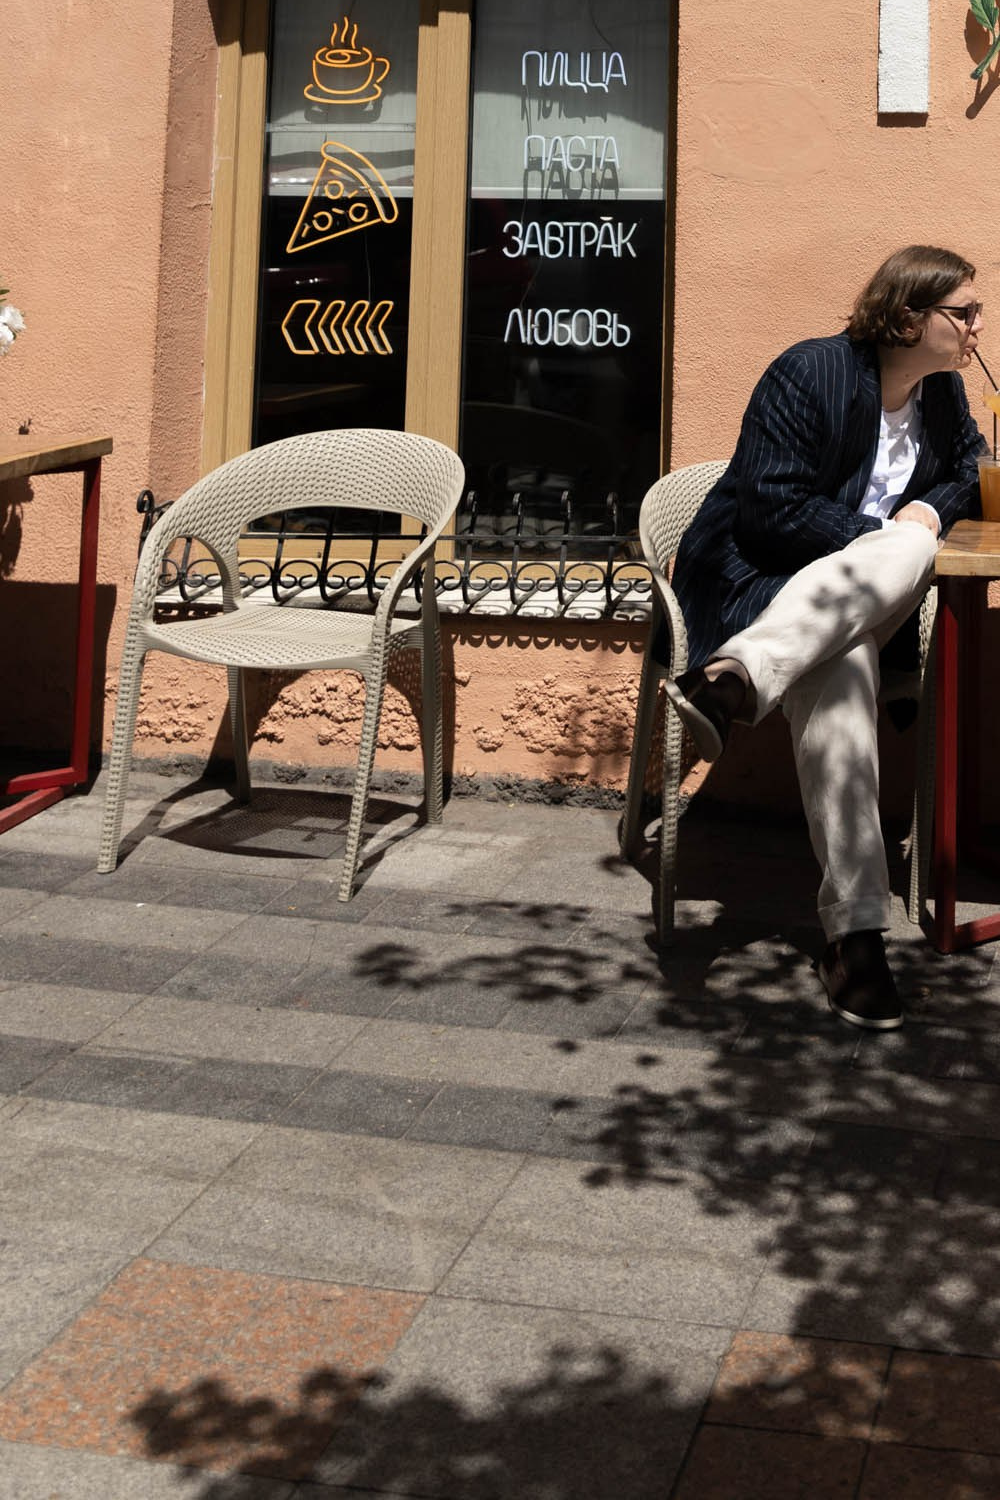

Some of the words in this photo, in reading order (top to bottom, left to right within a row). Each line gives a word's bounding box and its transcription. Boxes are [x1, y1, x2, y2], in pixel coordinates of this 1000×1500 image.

[522, 51, 627, 93] ПИЦЦА
[524, 135, 620, 173] ПАСТА
[502, 220, 638, 258] ЗАВТРАК
[504, 308, 631, 347] ЛЮБОВЬ
